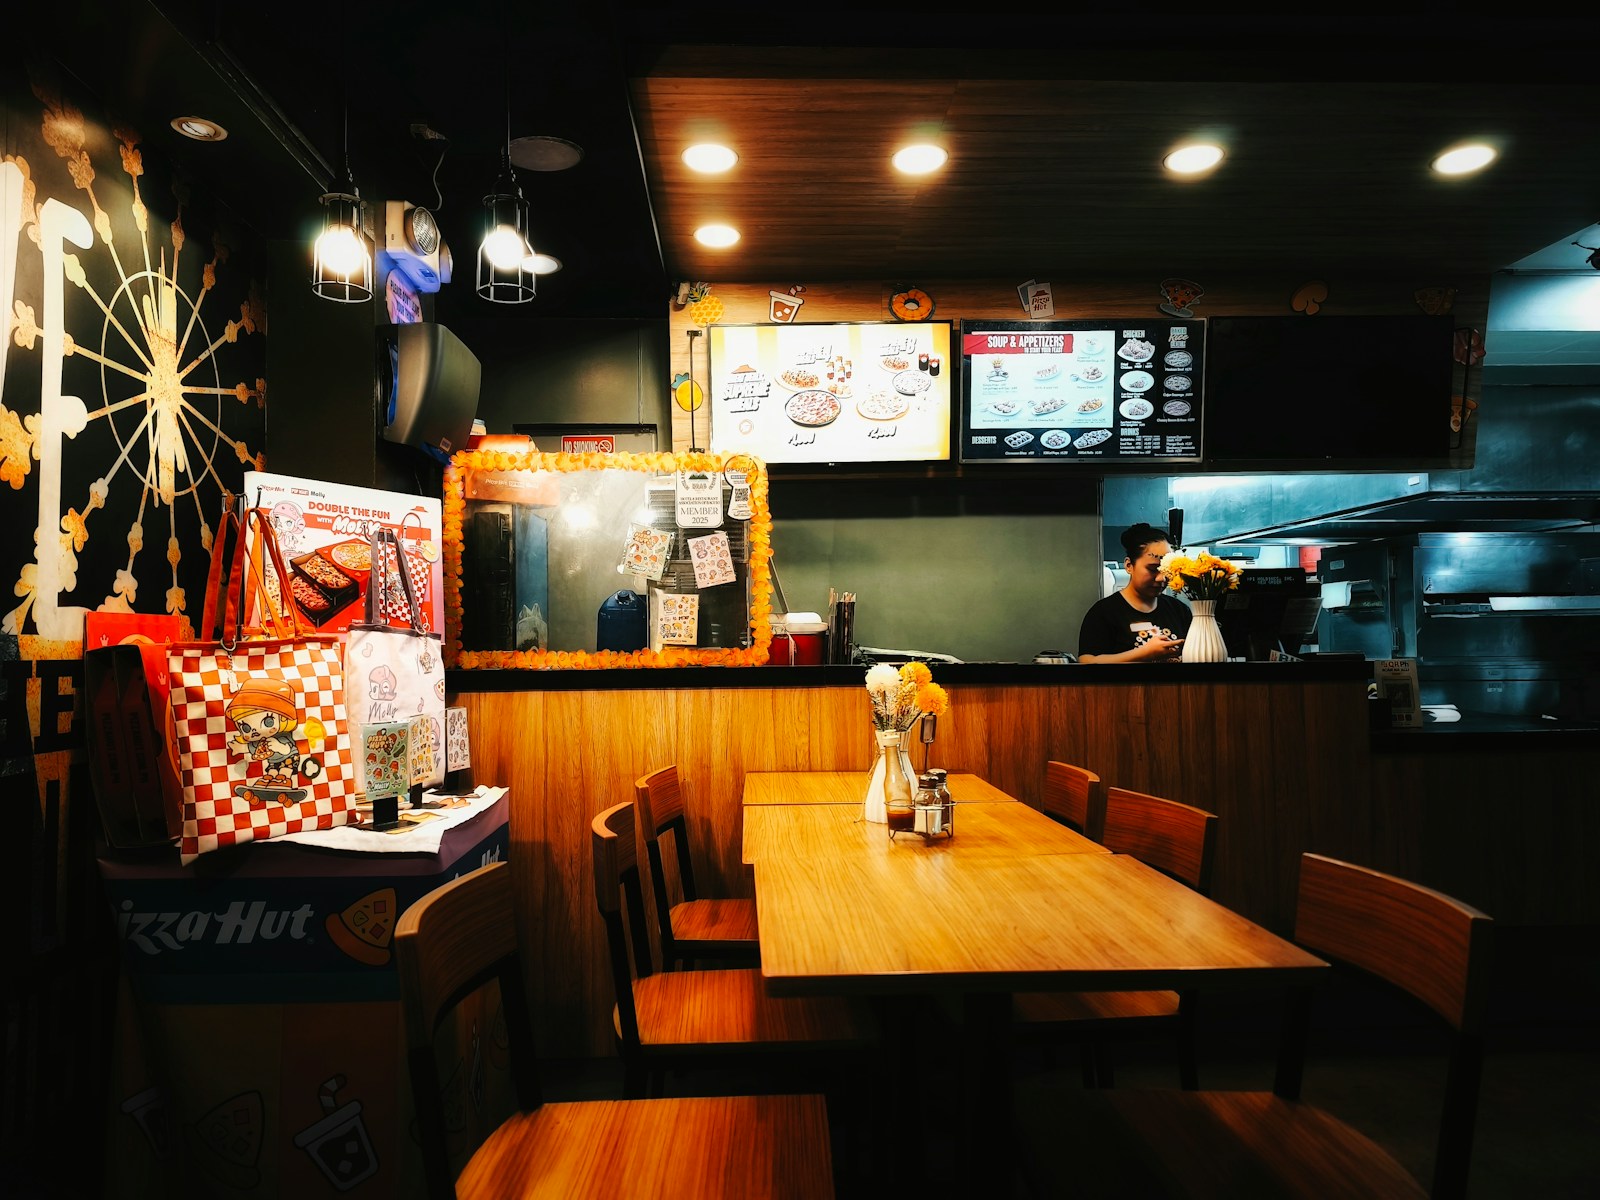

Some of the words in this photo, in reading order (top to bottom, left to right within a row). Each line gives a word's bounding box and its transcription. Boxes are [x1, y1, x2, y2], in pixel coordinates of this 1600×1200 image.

[1123, 329, 1145, 338] CHICKEN
[1168, 333, 1190, 342] Rice
[987, 335, 1008, 348] SOUP
[1009, 335, 1017, 348] &
[1018, 335, 1065, 347] APPETIZERS
[1121, 428, 1139, 436] DRINKS
[971, 435, 997, 444] DESSERTS
[564, 440, 572, 453] NO
[573, 440, 599, 453] SMOKING
[310, 490, 326, 499] Molly
[308, 501, 350, 515] DOUBLE
[351, 507, 370, 518] THE
[371, 510, 391, 520] FUN
[680, 507, 719, 515] MEMBER
[691, 516, 709, 524] 2025
[368, 702, 398, 722] Molly
[367, 735, 388, 744] PIZZA
[116, 899, 210, 956] izza
[206, 900, 314, 945] Hut
